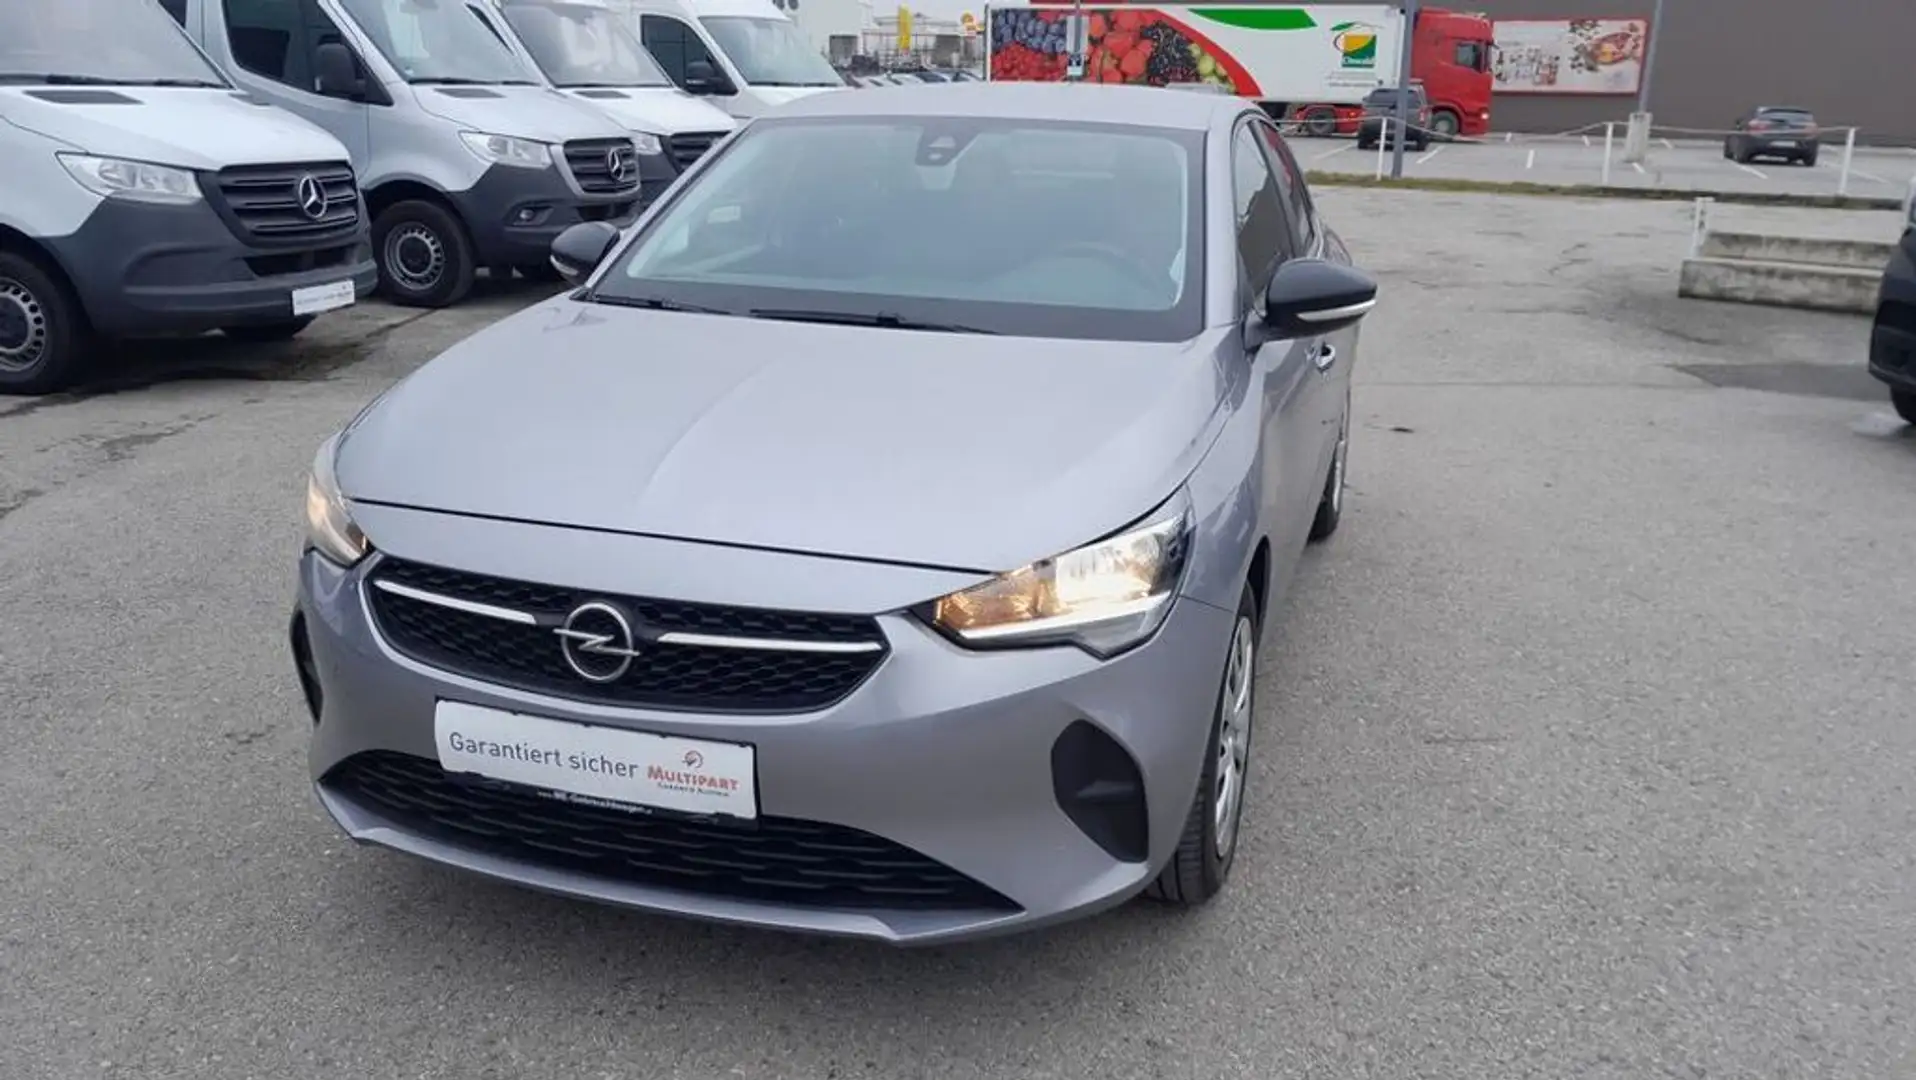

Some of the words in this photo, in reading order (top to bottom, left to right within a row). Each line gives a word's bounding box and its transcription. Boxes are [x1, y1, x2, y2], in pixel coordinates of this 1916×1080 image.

[449, 731, 562, 767] Garantiert
[568, 752, 639, 779] sicher
[647, 764, 739, 791] MULTIPART
